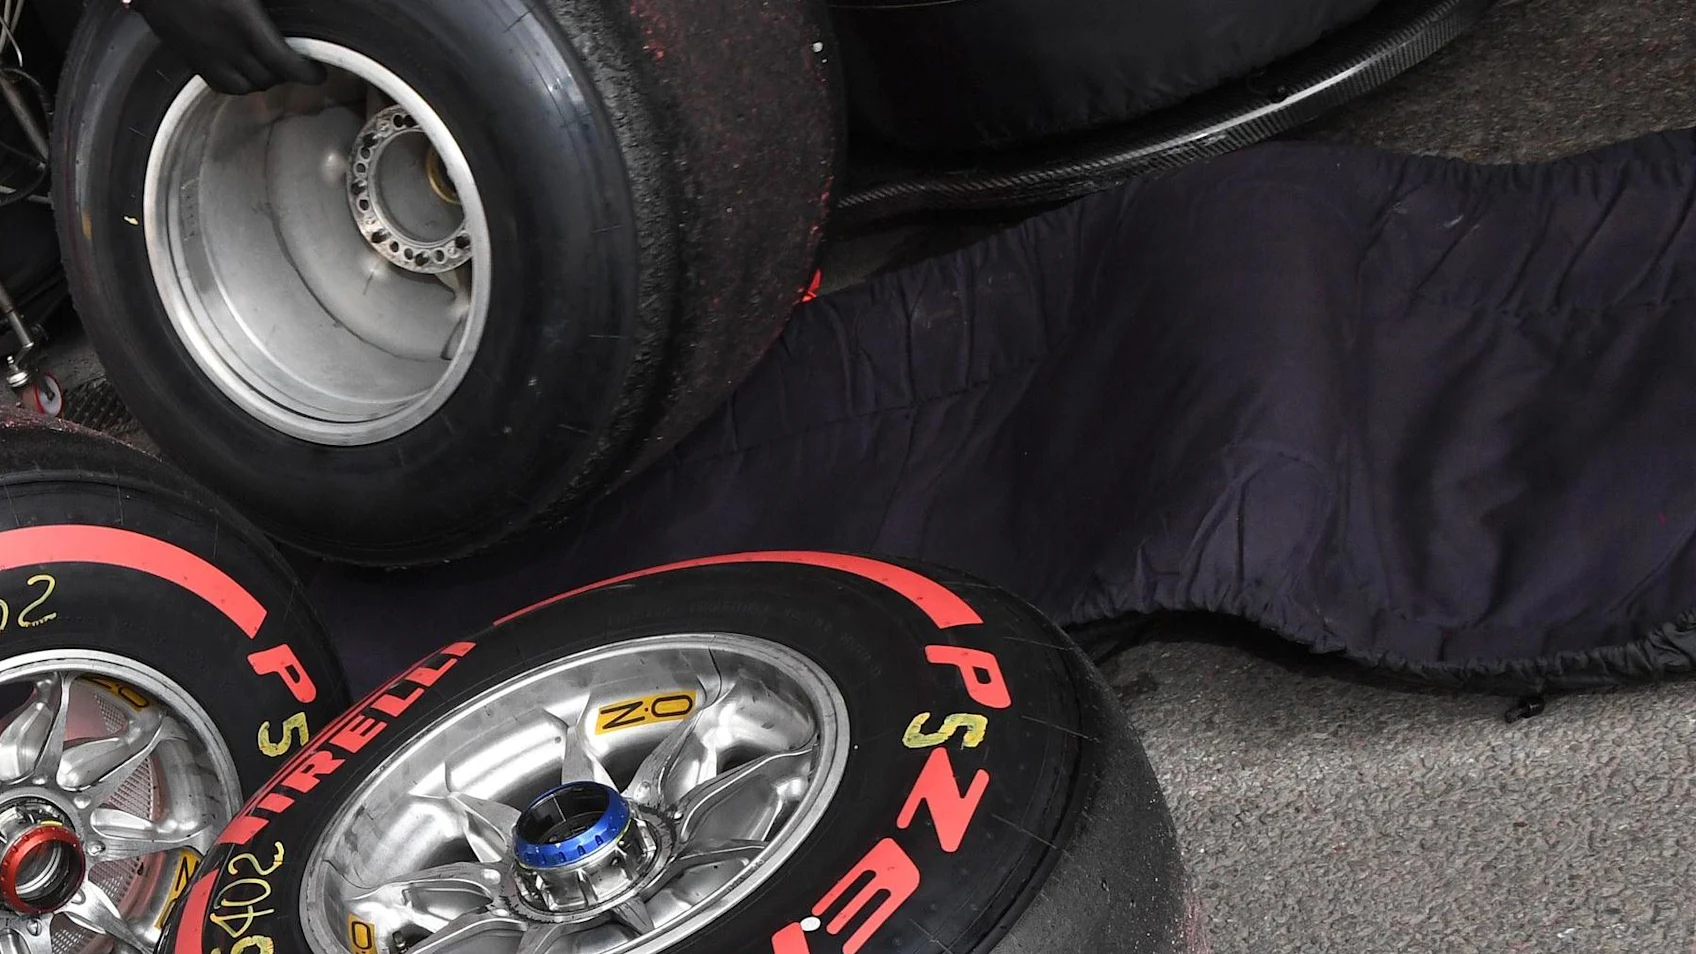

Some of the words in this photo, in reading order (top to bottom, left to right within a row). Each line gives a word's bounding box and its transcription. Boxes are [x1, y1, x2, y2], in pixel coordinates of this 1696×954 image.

[247, 643, 317, 703] P
[215, 641, 477, 845] PIRELLI
[258, 711, 310, 757] 5
[902, 711, 988, 750] 5
